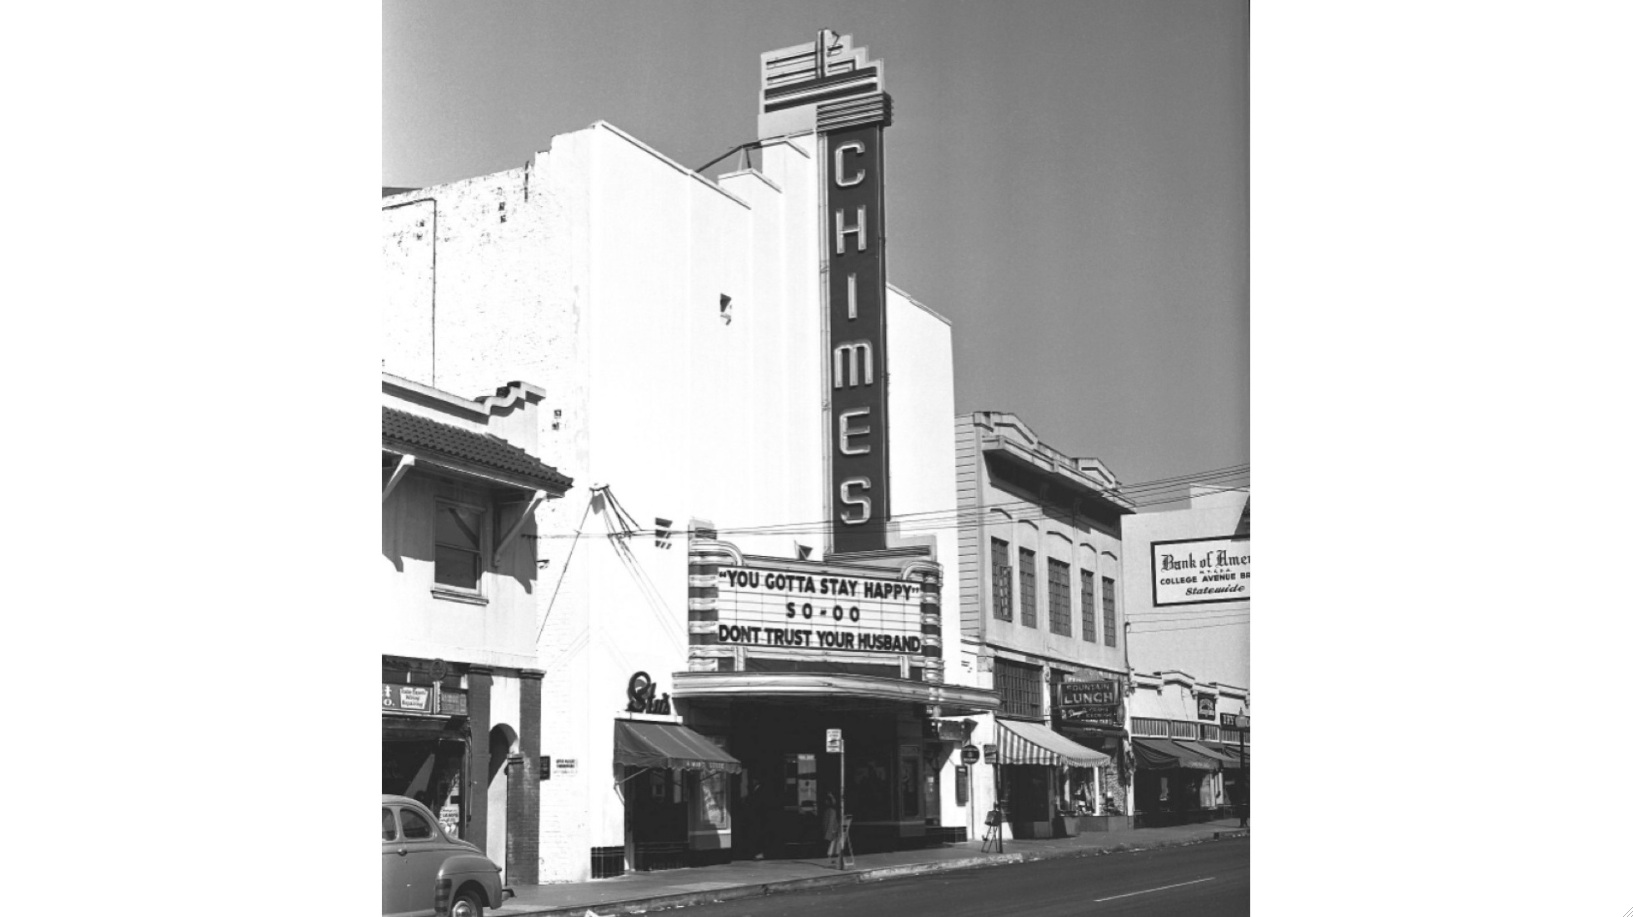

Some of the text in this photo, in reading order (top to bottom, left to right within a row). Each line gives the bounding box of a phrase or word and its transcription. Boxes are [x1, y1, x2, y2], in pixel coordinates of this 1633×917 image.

[834, 141, 874, 526] CHIMES
[1161, 552, 1197, 572] Bank
[1200, 551, 1213, 568] of
[765, 573, 815, 593] GOTTA
[820, 578, 858, 597] STAY
[1160, 576, 1197, 585] COLLEGE
[1202, 573, 1236, 582] AVENUE
[1185, 584, 1245, 596] Statewide
[765, 628, 812, 646] TRUST
[816, 631, 855, 649] YOUR
[858, 634, 921, 652] HUSBAND
[1064, 692, 1113, 704] LUNCH
